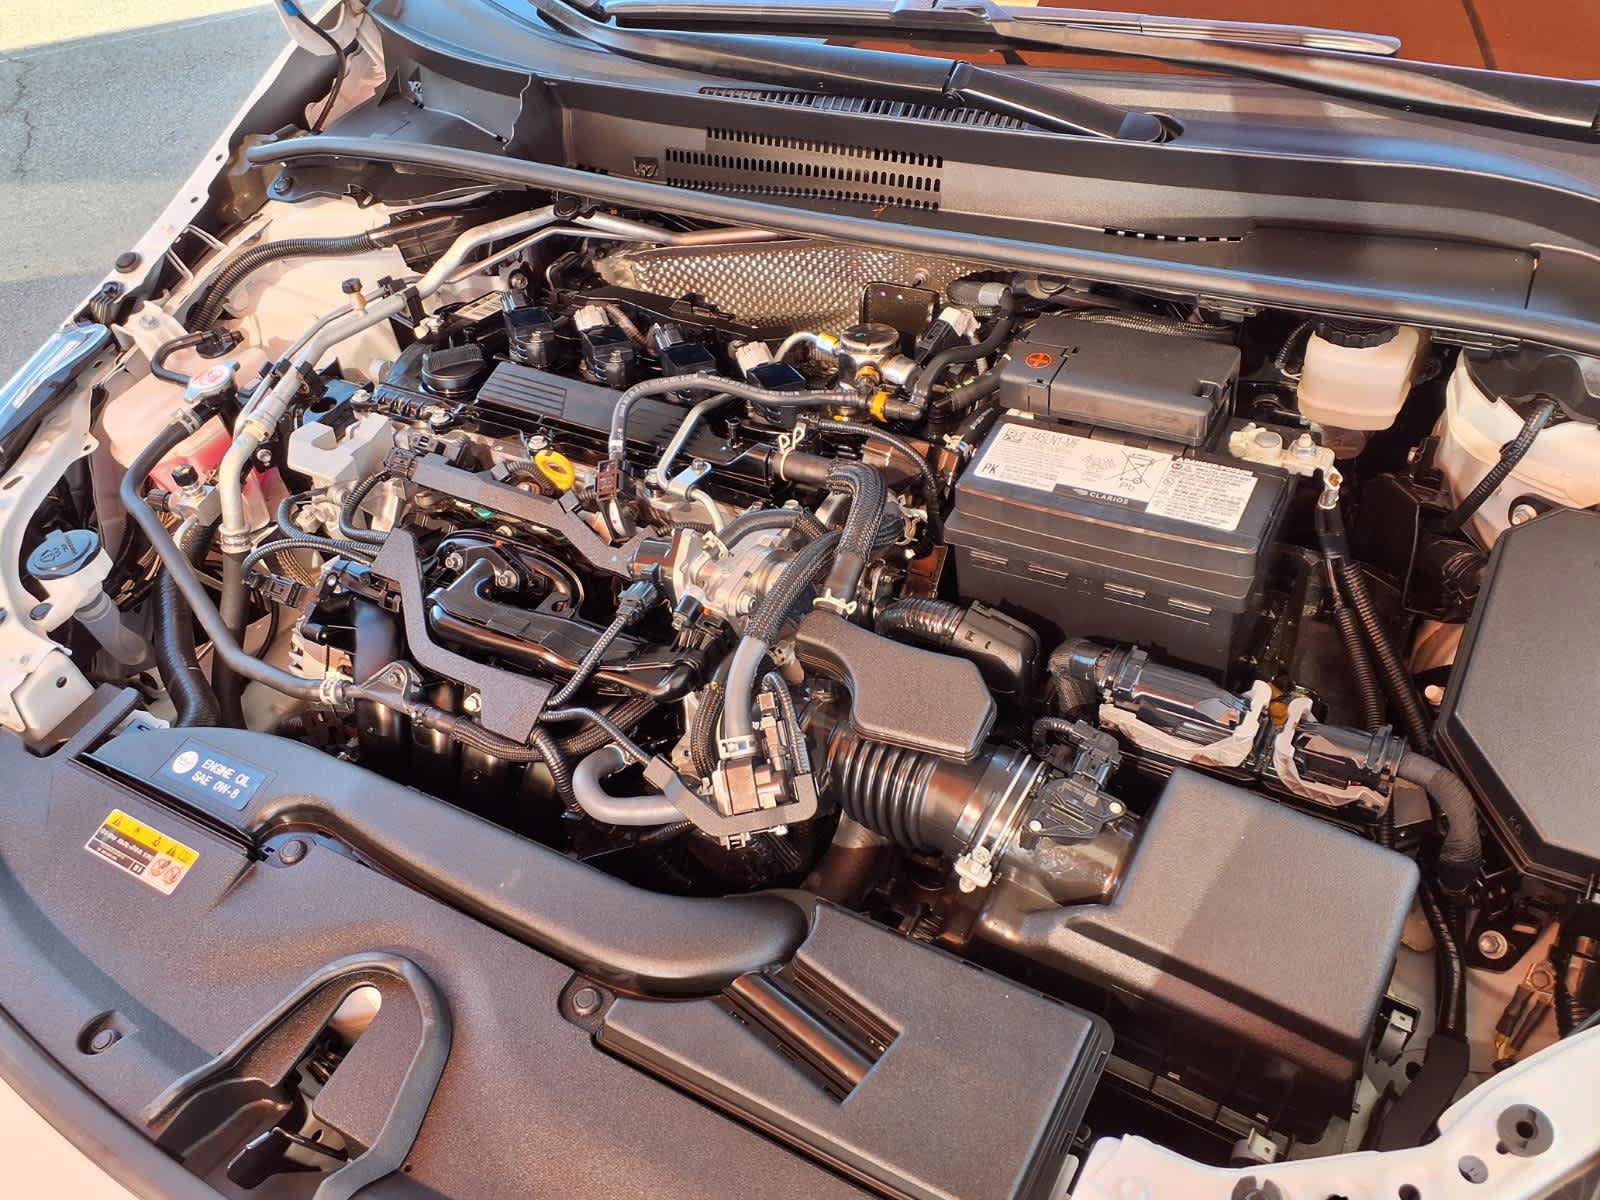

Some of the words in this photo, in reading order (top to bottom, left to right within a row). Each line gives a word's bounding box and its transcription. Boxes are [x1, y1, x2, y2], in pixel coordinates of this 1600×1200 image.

[981, 462, 999, 475] PK
[1089, 491, 1129, 505] CLARIOS
[201, 759, 235, 779] ENGINE
[191, 771, 213, 786] SAE
